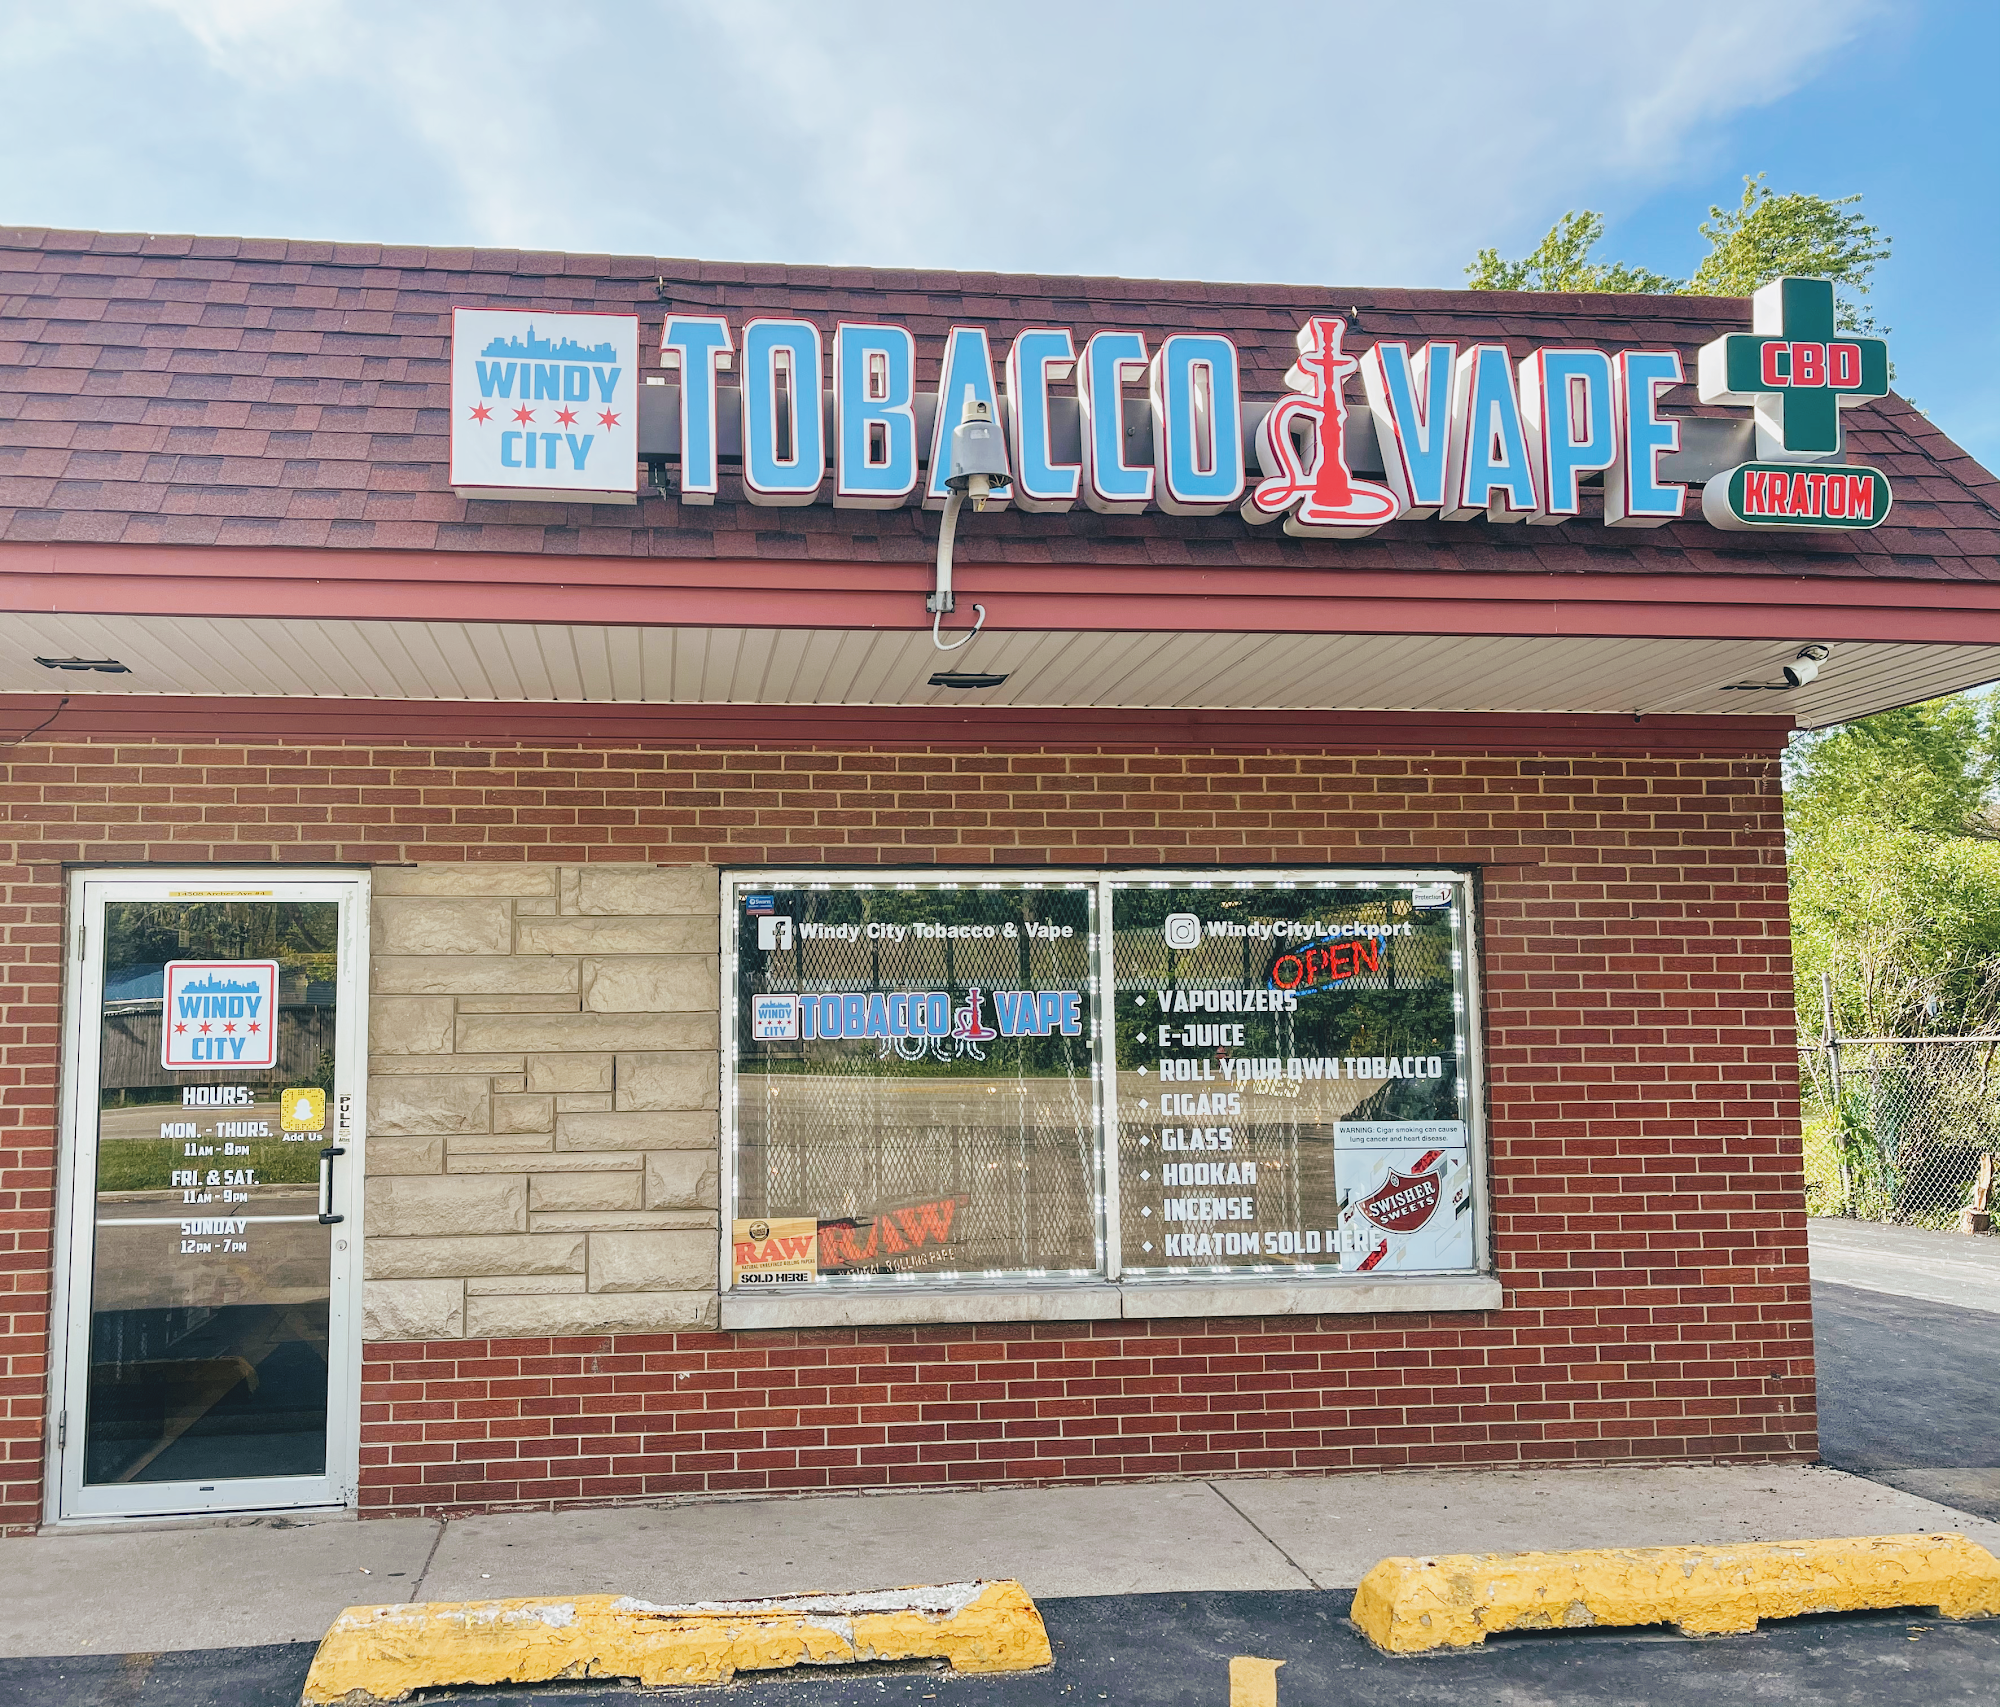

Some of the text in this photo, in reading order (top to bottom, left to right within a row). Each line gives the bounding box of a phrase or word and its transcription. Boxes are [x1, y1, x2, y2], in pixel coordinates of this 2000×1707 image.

[1759, 340, 1863, 389] CBD
[475, 361, 622, 404] WINDY
[660, 313, 1688, 519] TOBACCO VAPE
[500, 430, 594, 471] CITY
[1742, 470, 1876, 521] KRATOM
[799, 921, 1074, 943] Windy City Tobacco & Vape
[1207, 919, 1412, 940] WindyCityLockport
[1272, 936, 1379, 990] OPEN
[177, 995, 262, 1019] WINDY
[1158, 989, 1298, 1013] VAPORIZERS
[758, 1008, 792, 1019] WINDY
[799, 990, 1082, 1039] TOBACCO VAPE
[764, 1026, 786, 1036] CITY
[1158, 1024, 1245, 1047] E-JUICE
[191, 1036, 246, 1060] CITY
[1159, 1056, 1442, 1081] ROLL YOUR OWN TOBACCO
[182, 1086, 255, 1106] HOURS:
[1161, 1092, 1241, 1116] CIGARS
[340, 1096, 351, 1128] PULL
[160, 1122, 202, 1139] MON.
[216, 1121, 274, 1138] THURS.
[282, 1133, 323, 1142] Add Us
[1161, 1127, 1233, 1151] GLASS
[1339, 1126, 1375, 1134] WARNING:
[1376, 1126, 1395, 1135] Cigar
[1396, 1126, 1424, 1135] smoking
[1349, 1135, 1365, 1143] lung
[1421, 1134, 1449, 1142] disease.
[184, 1143, 214, 1157] 11AM
[224, 1142, 250, 1156] 8PM
[171, 1169, 260, 1187] FRI. & SAT.
[1163, 1161, 1257, 1186] HOOKAH
[182, 1190, 213, 1204] 11AM
[223, 1189, 248, 1203] 9PM
[1369, 1180, 1436, 1218] SWISHER
[1163, 1197, 1254, 1221] INCENSE
[1380, 1196, 1435, 1225] SWEETS
[180, 1219, 248, 1236] SUNDAY
[817, 1199, 956, 1268] RAW
[180, 1239, 212, 1254] 12PM
[223, 1238, 248, 1253] 7PM
[734, 1235, 814, 1266] RAW
[1165, 1229, 1382, 1257] KRATOM SOLD HERE
[885, 1253, 928, 1273] ROLLING
[741, 1272, 809, 1284] SOLD HERE
